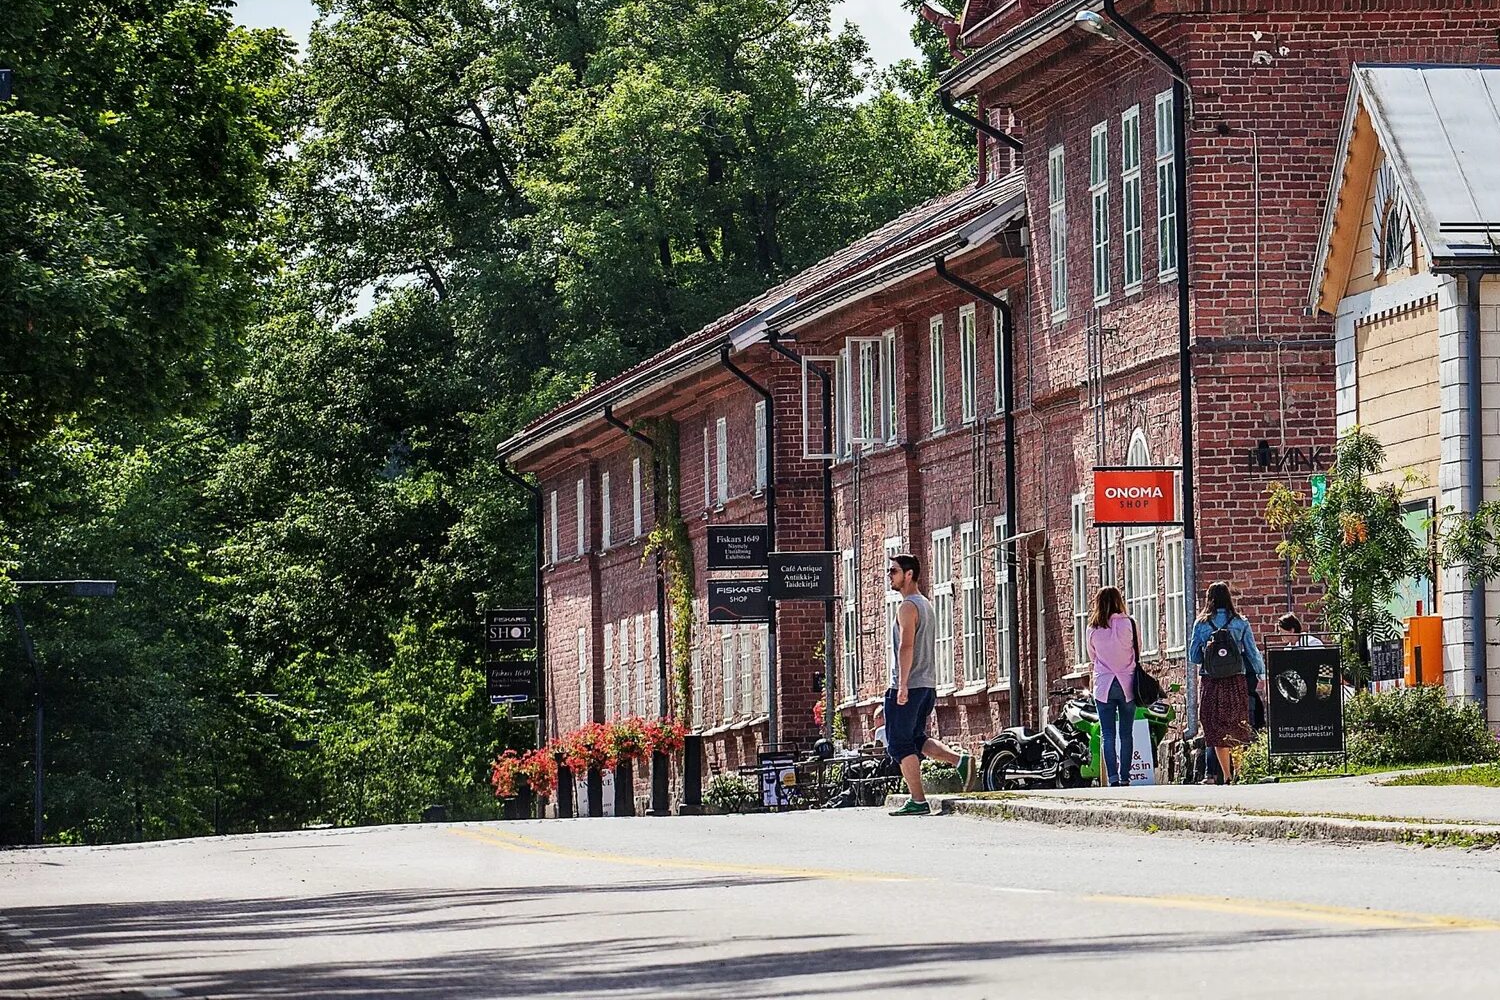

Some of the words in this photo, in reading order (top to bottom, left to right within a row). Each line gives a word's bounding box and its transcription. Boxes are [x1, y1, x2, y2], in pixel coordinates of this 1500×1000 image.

[1105, 487, 1163, 498] ONOMA
[1120, 500, 1149, 509] SHOP
[716, 535, 742, 543] Fiskars
[743, 535, 760, 543] 1649
[780, 565, 796, 573] Café
[796, 565, 823, 573] Antique
[490, 627, 531, 638] SHOP
[1297, 724, 1334, 732] mustajärvi
